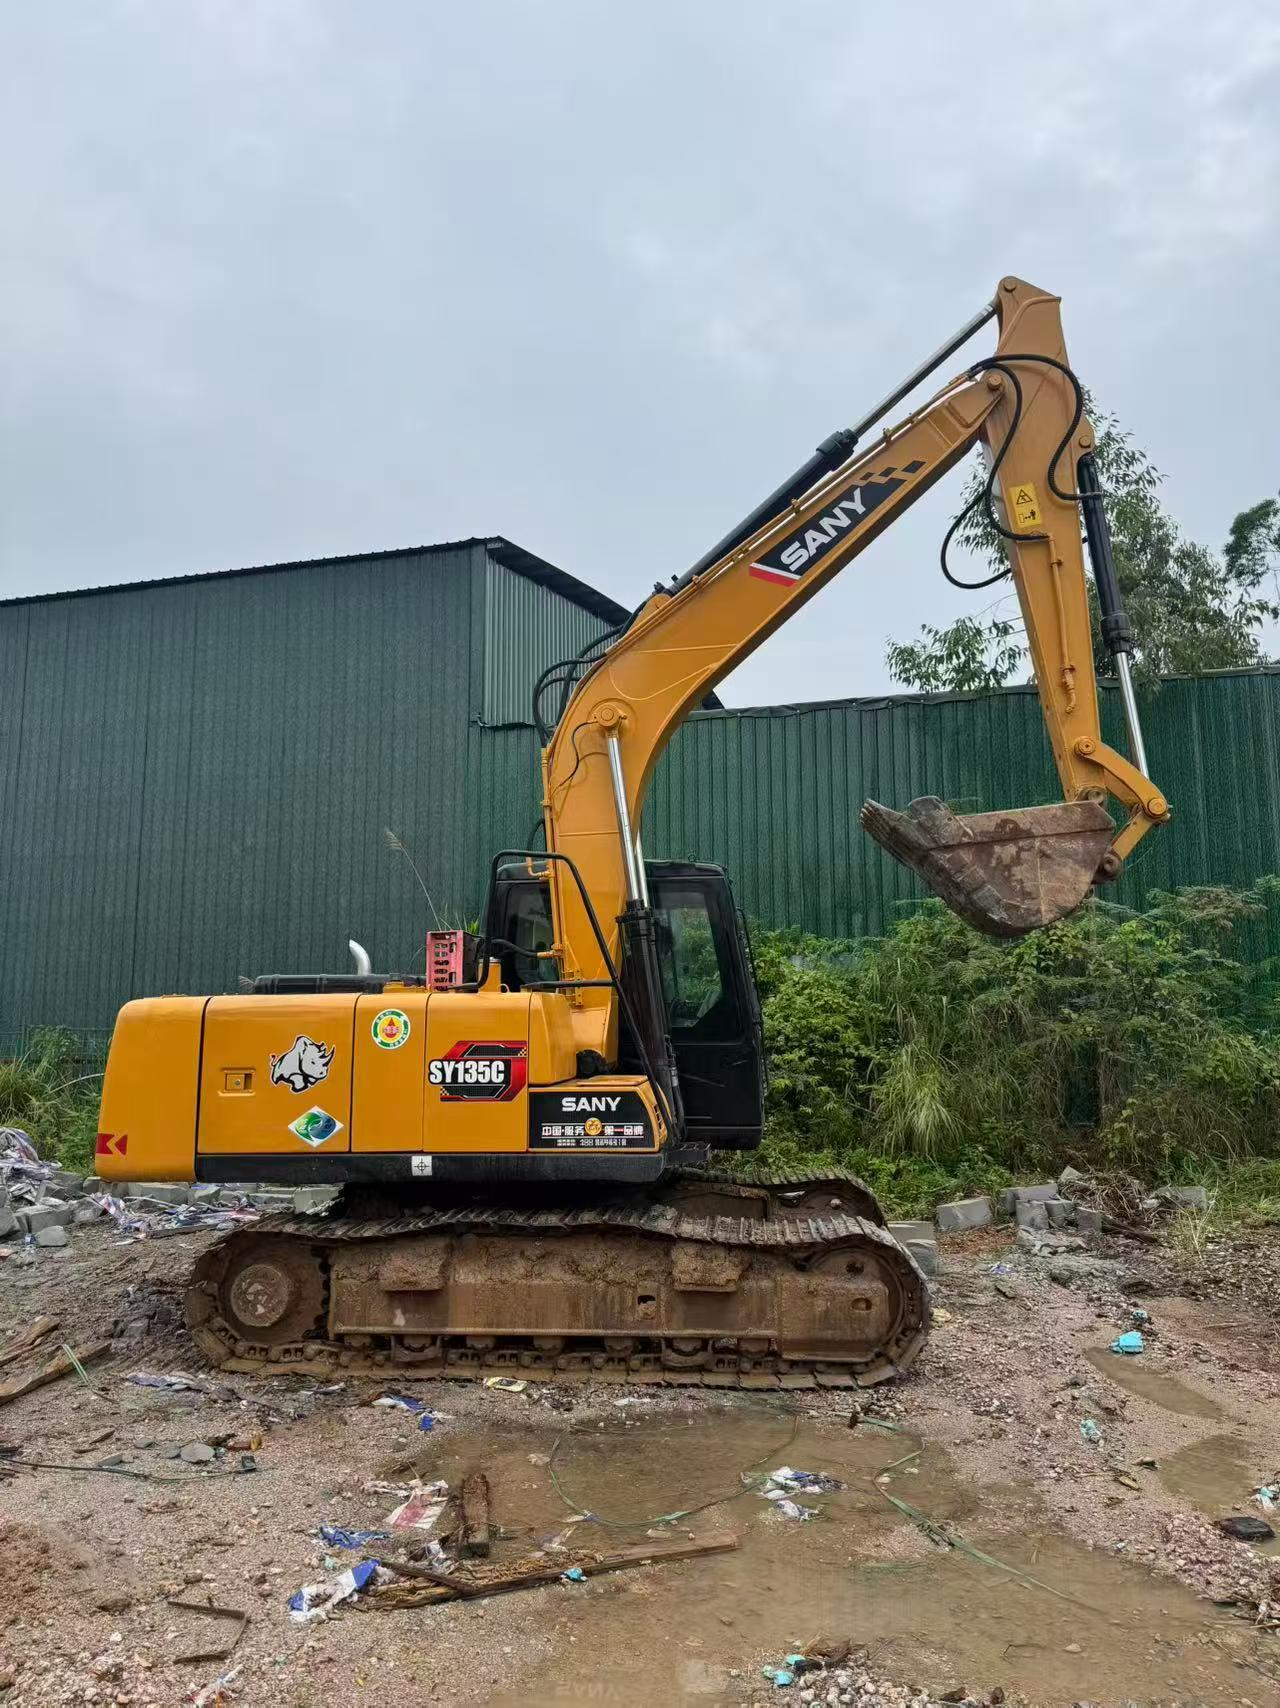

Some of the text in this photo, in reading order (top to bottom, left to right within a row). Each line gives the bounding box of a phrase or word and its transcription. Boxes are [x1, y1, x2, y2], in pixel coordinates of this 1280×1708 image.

[780, 487, 867, 572] SANY
[429, 1060, 505, 1084] SY135C
[562, 1097, 621, 1112] SANY
